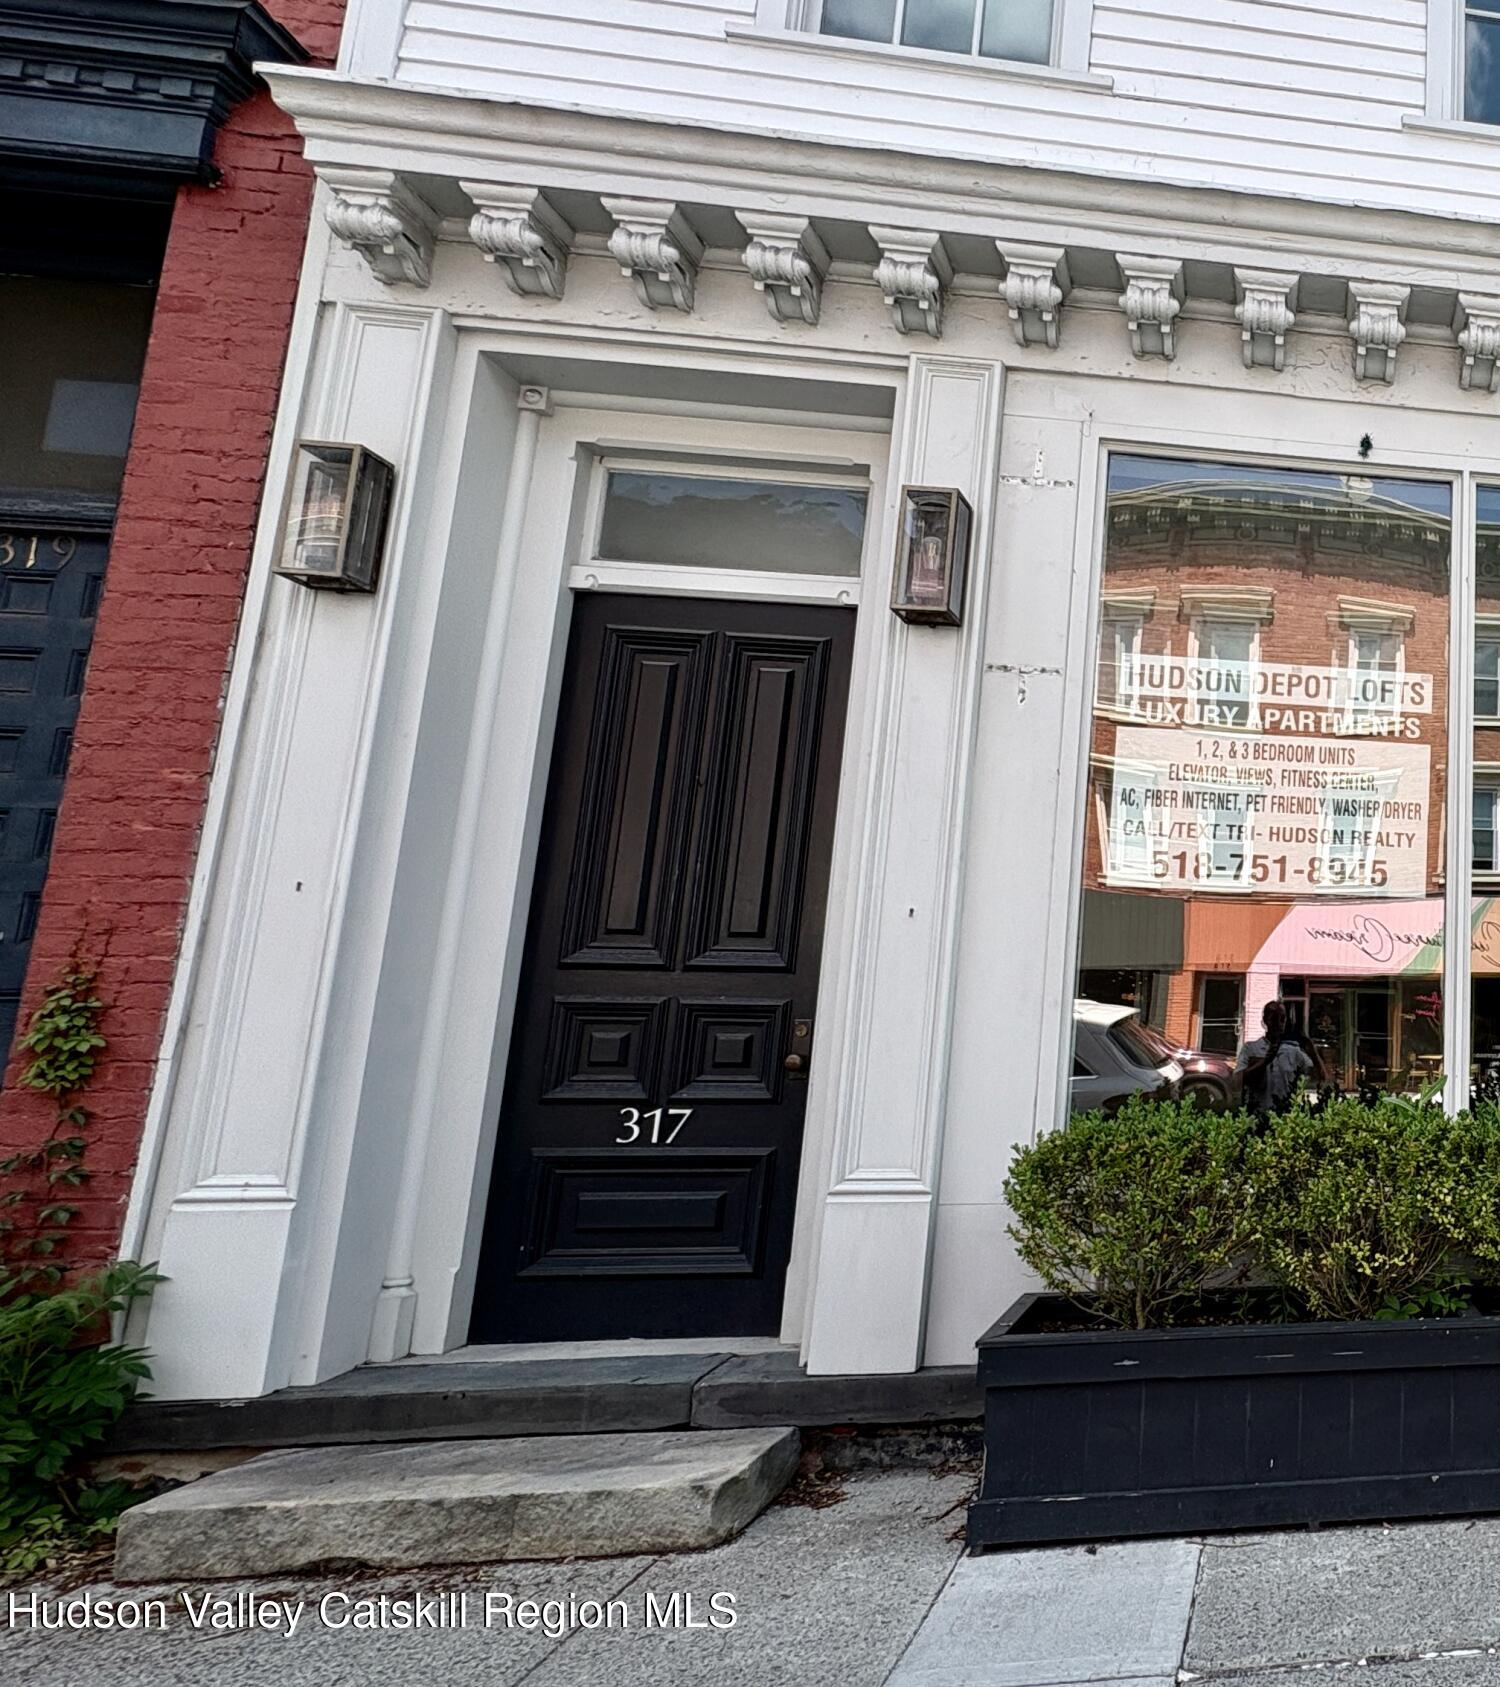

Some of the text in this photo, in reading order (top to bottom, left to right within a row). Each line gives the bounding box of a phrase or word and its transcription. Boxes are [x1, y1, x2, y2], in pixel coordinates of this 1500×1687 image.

[1128, 663, 1425, 706] HUDSON DEPOT LOFTS
[1246, 706, 1421, 739] APARTMENTS
[1196, 740, 1356, 766] 1, 2, & 3 BEDROOM UNITS
[1281, 769, 1328, 789] FITNESS
[1120, 787, 1140, 810] AC,
[1144, 789, 1178, 809] FIBER
[1182, 790, 1242, 815] INTERNET,
[1246, 793, 1268, 812] PET
[1332, 798, 1422, 821] WASHER/DRYER
[1123, 819, 1221, 840] CALL/TEXT
[1269, 826, 1345, 845] HUDSON
[1351, 830, 1416, 849] REALTY
[1152, 850, 1388, 887] 518-751-8945
[615, 1107, 694, 1144] 317
